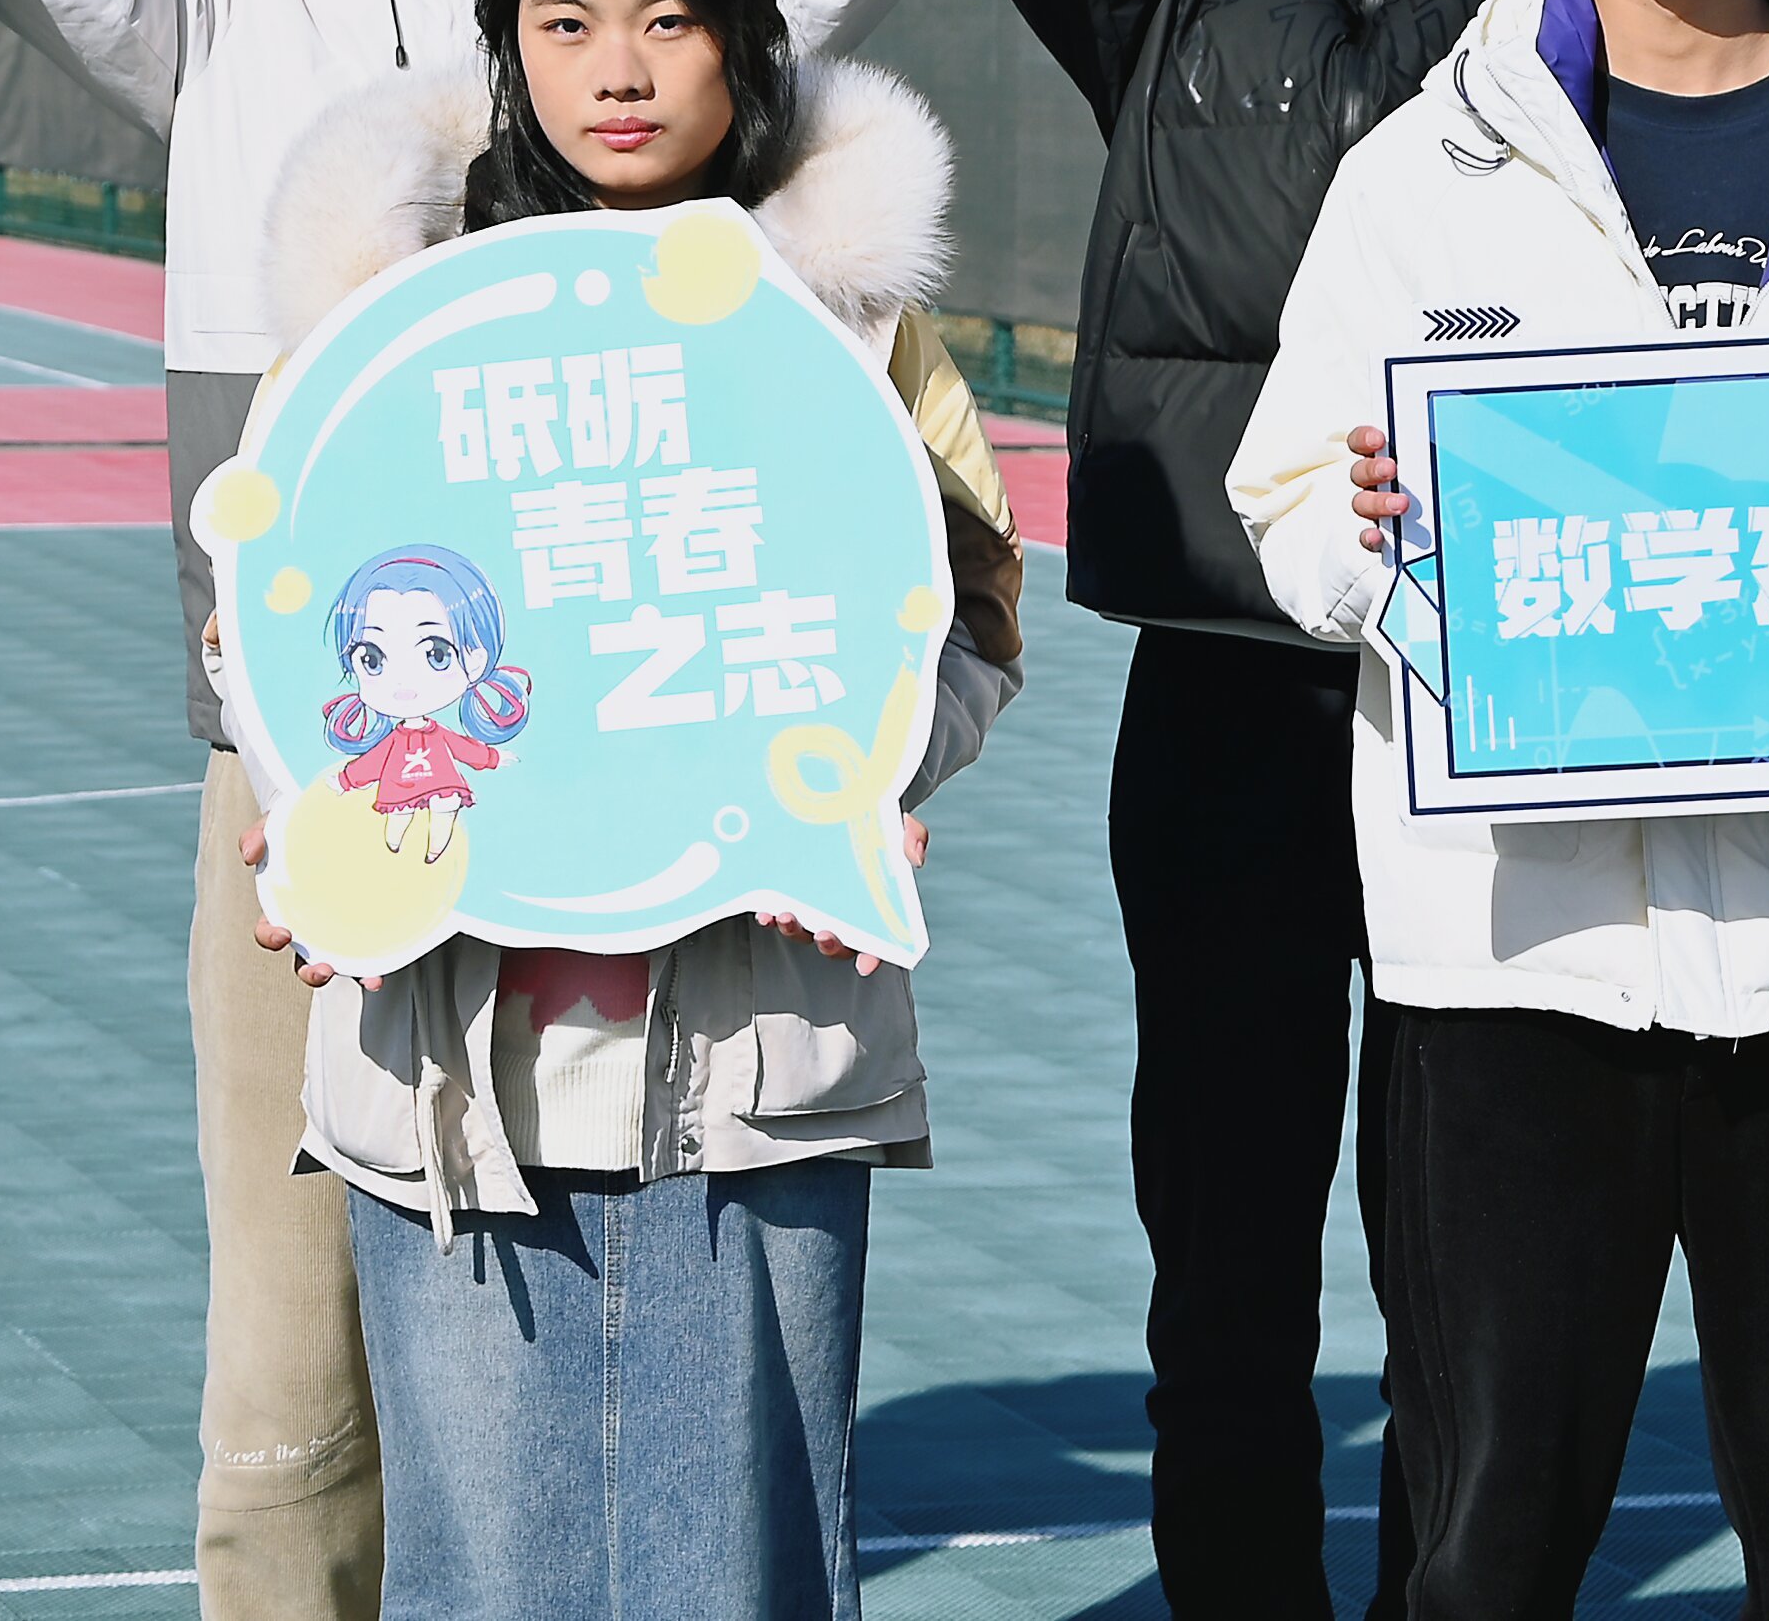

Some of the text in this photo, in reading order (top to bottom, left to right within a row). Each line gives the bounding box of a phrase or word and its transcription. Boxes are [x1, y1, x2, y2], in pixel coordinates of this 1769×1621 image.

[432, 342, 691, 483] 砥砺
[509, 466, 765, 609] 青春
[587, 590, 847, 733] 之志
